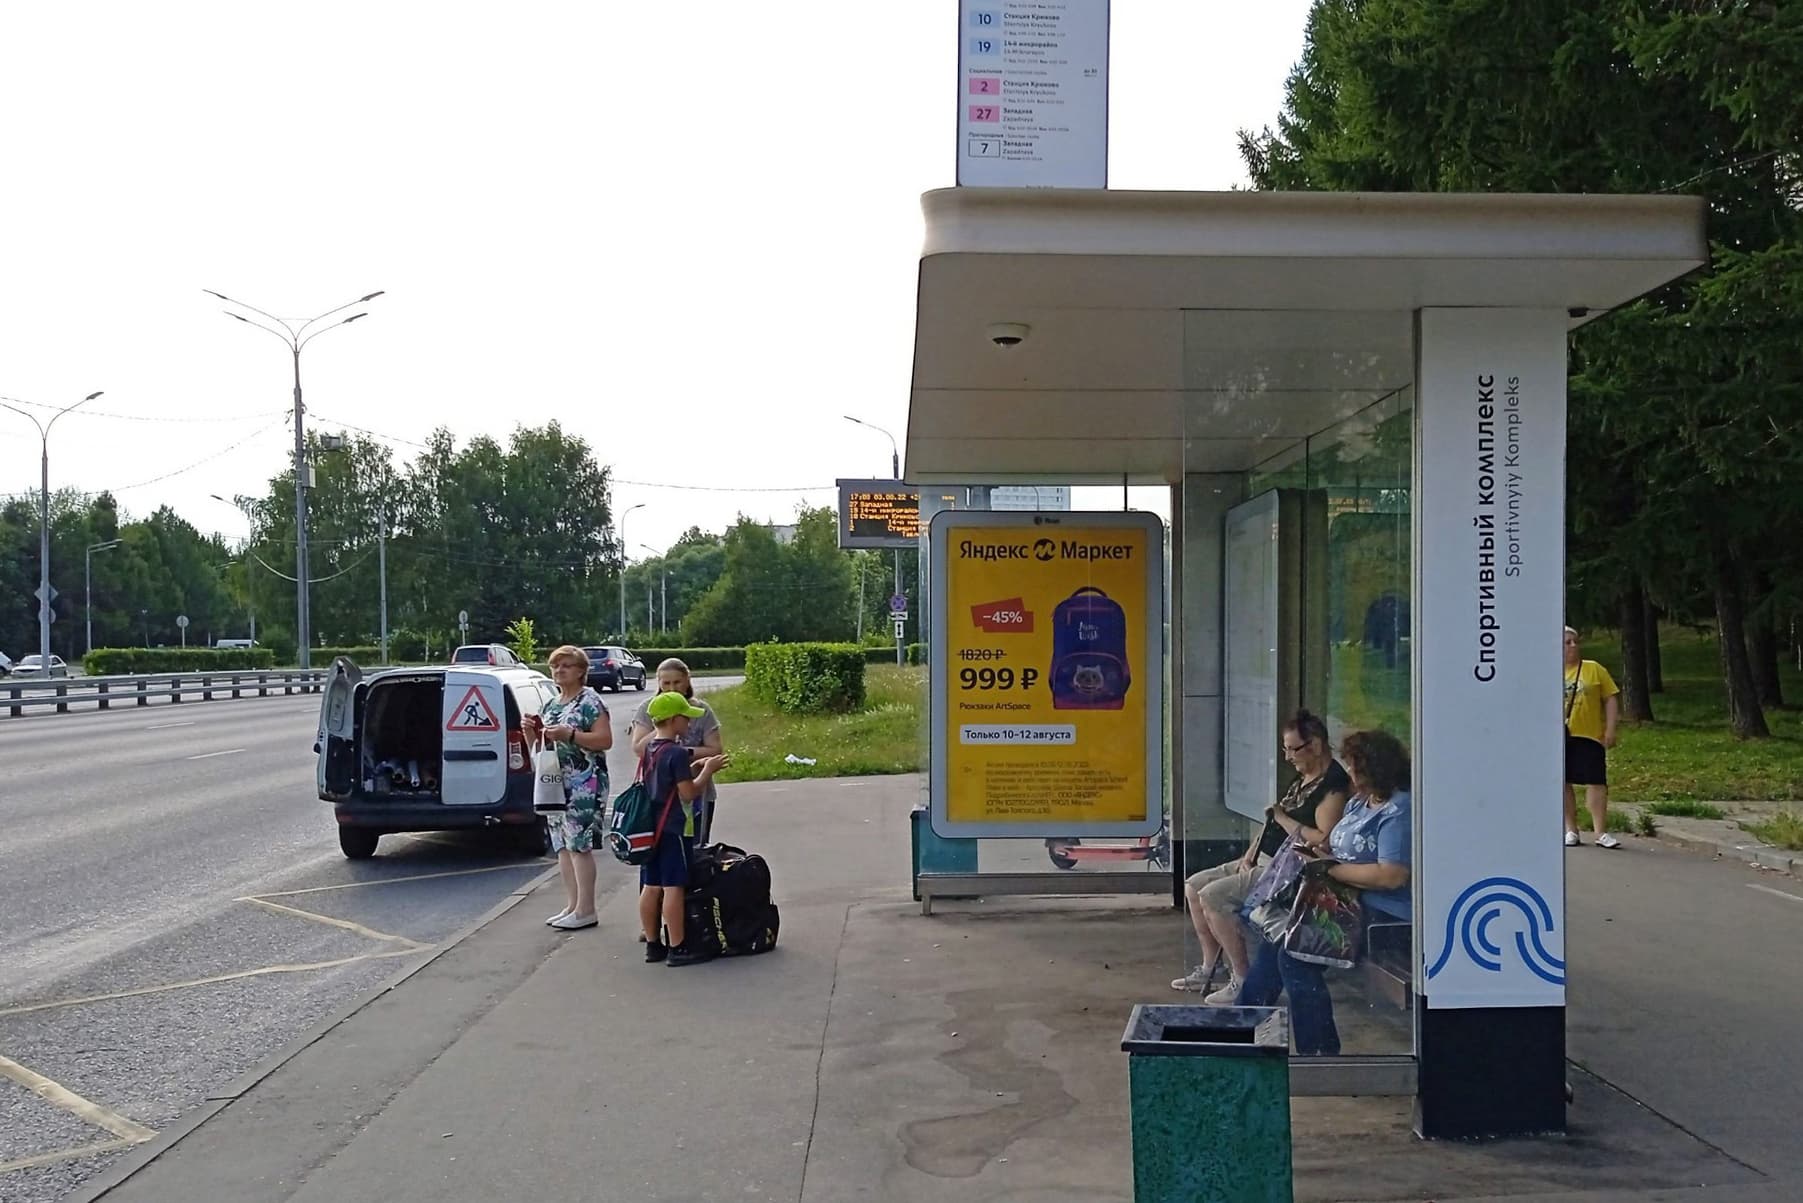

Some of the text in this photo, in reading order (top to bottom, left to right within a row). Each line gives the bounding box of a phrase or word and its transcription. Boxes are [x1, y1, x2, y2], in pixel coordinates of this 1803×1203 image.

[978, 13, 992, 25] 10
[978, 41, 992, 53] 19
[980, 81, 989, 93] 2
[976, 108, 992, 121] 27
[1003, 107, 1033, 115] Западная
[980, 142, 989, 154] 7
[1003, 140, 1033, 148] Западная
[1503, 376, 1523, 577] Sportivnyiy Kompleks
[1473, 375, 1500, 682] Спортивный комплекс
[960, 540, 1133, 563] Яндекс Маркет
[960, 648, 992, 661] 1820
[960, 667, 1015, 691] 999
[960, 702, 1032, 713] Рюкзаки ArtSpace
[965, 729, 1000, 740] Только
[1032, 731, 1071, 742] августа
